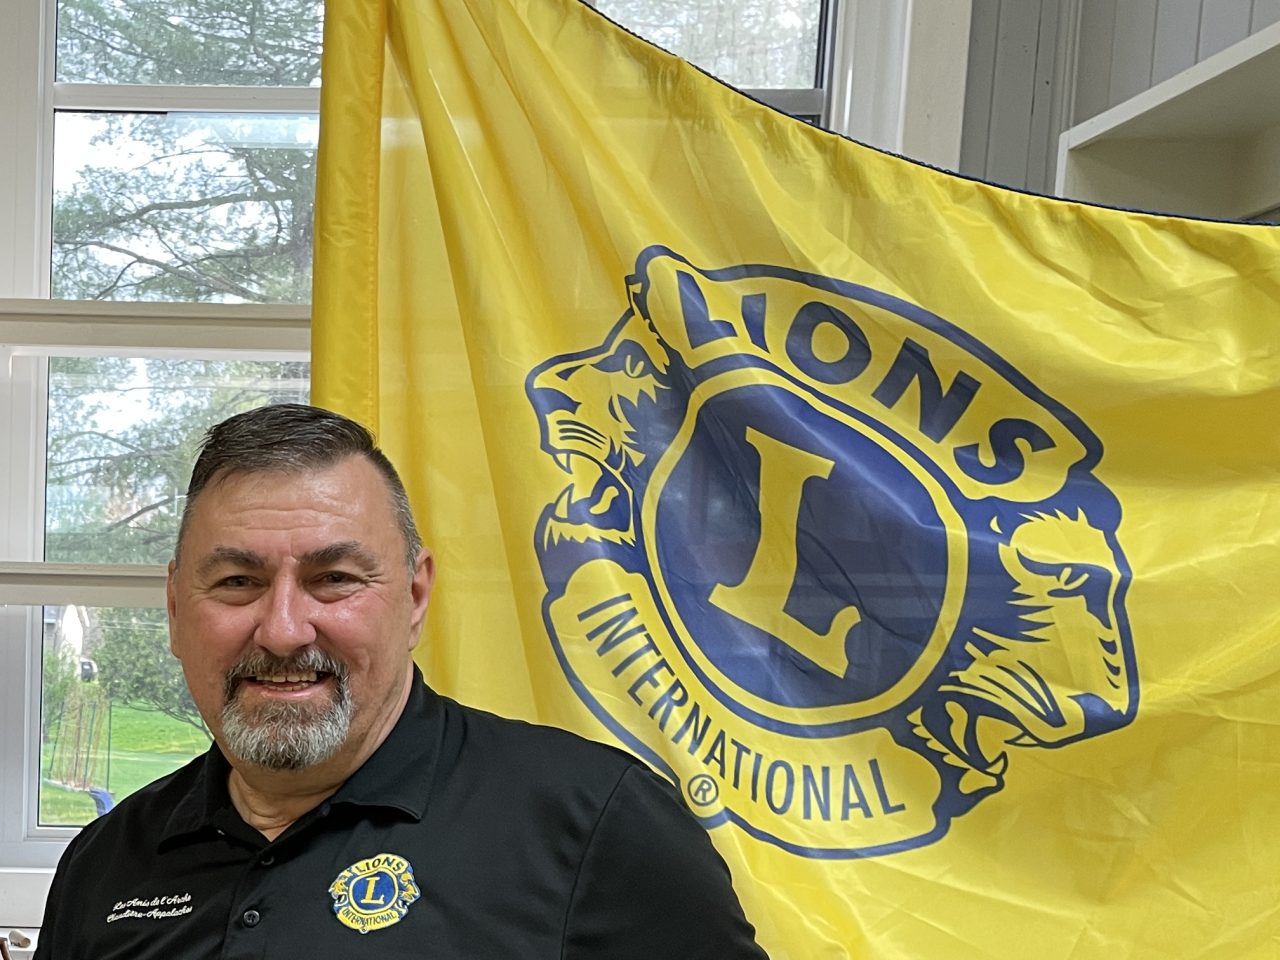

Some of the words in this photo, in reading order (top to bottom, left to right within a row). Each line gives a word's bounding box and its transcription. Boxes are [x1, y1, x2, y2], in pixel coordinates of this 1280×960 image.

[677, 269, 1058, 484] LIONS
[708, 426, 862, 679] L
[577, 592, 907, 822] INTERNATIONAL
[341, 909, 397, 926] INTERNATIONAL
[355, 857, 404, 873] LIONS
[360, 876, 385, 905] L
